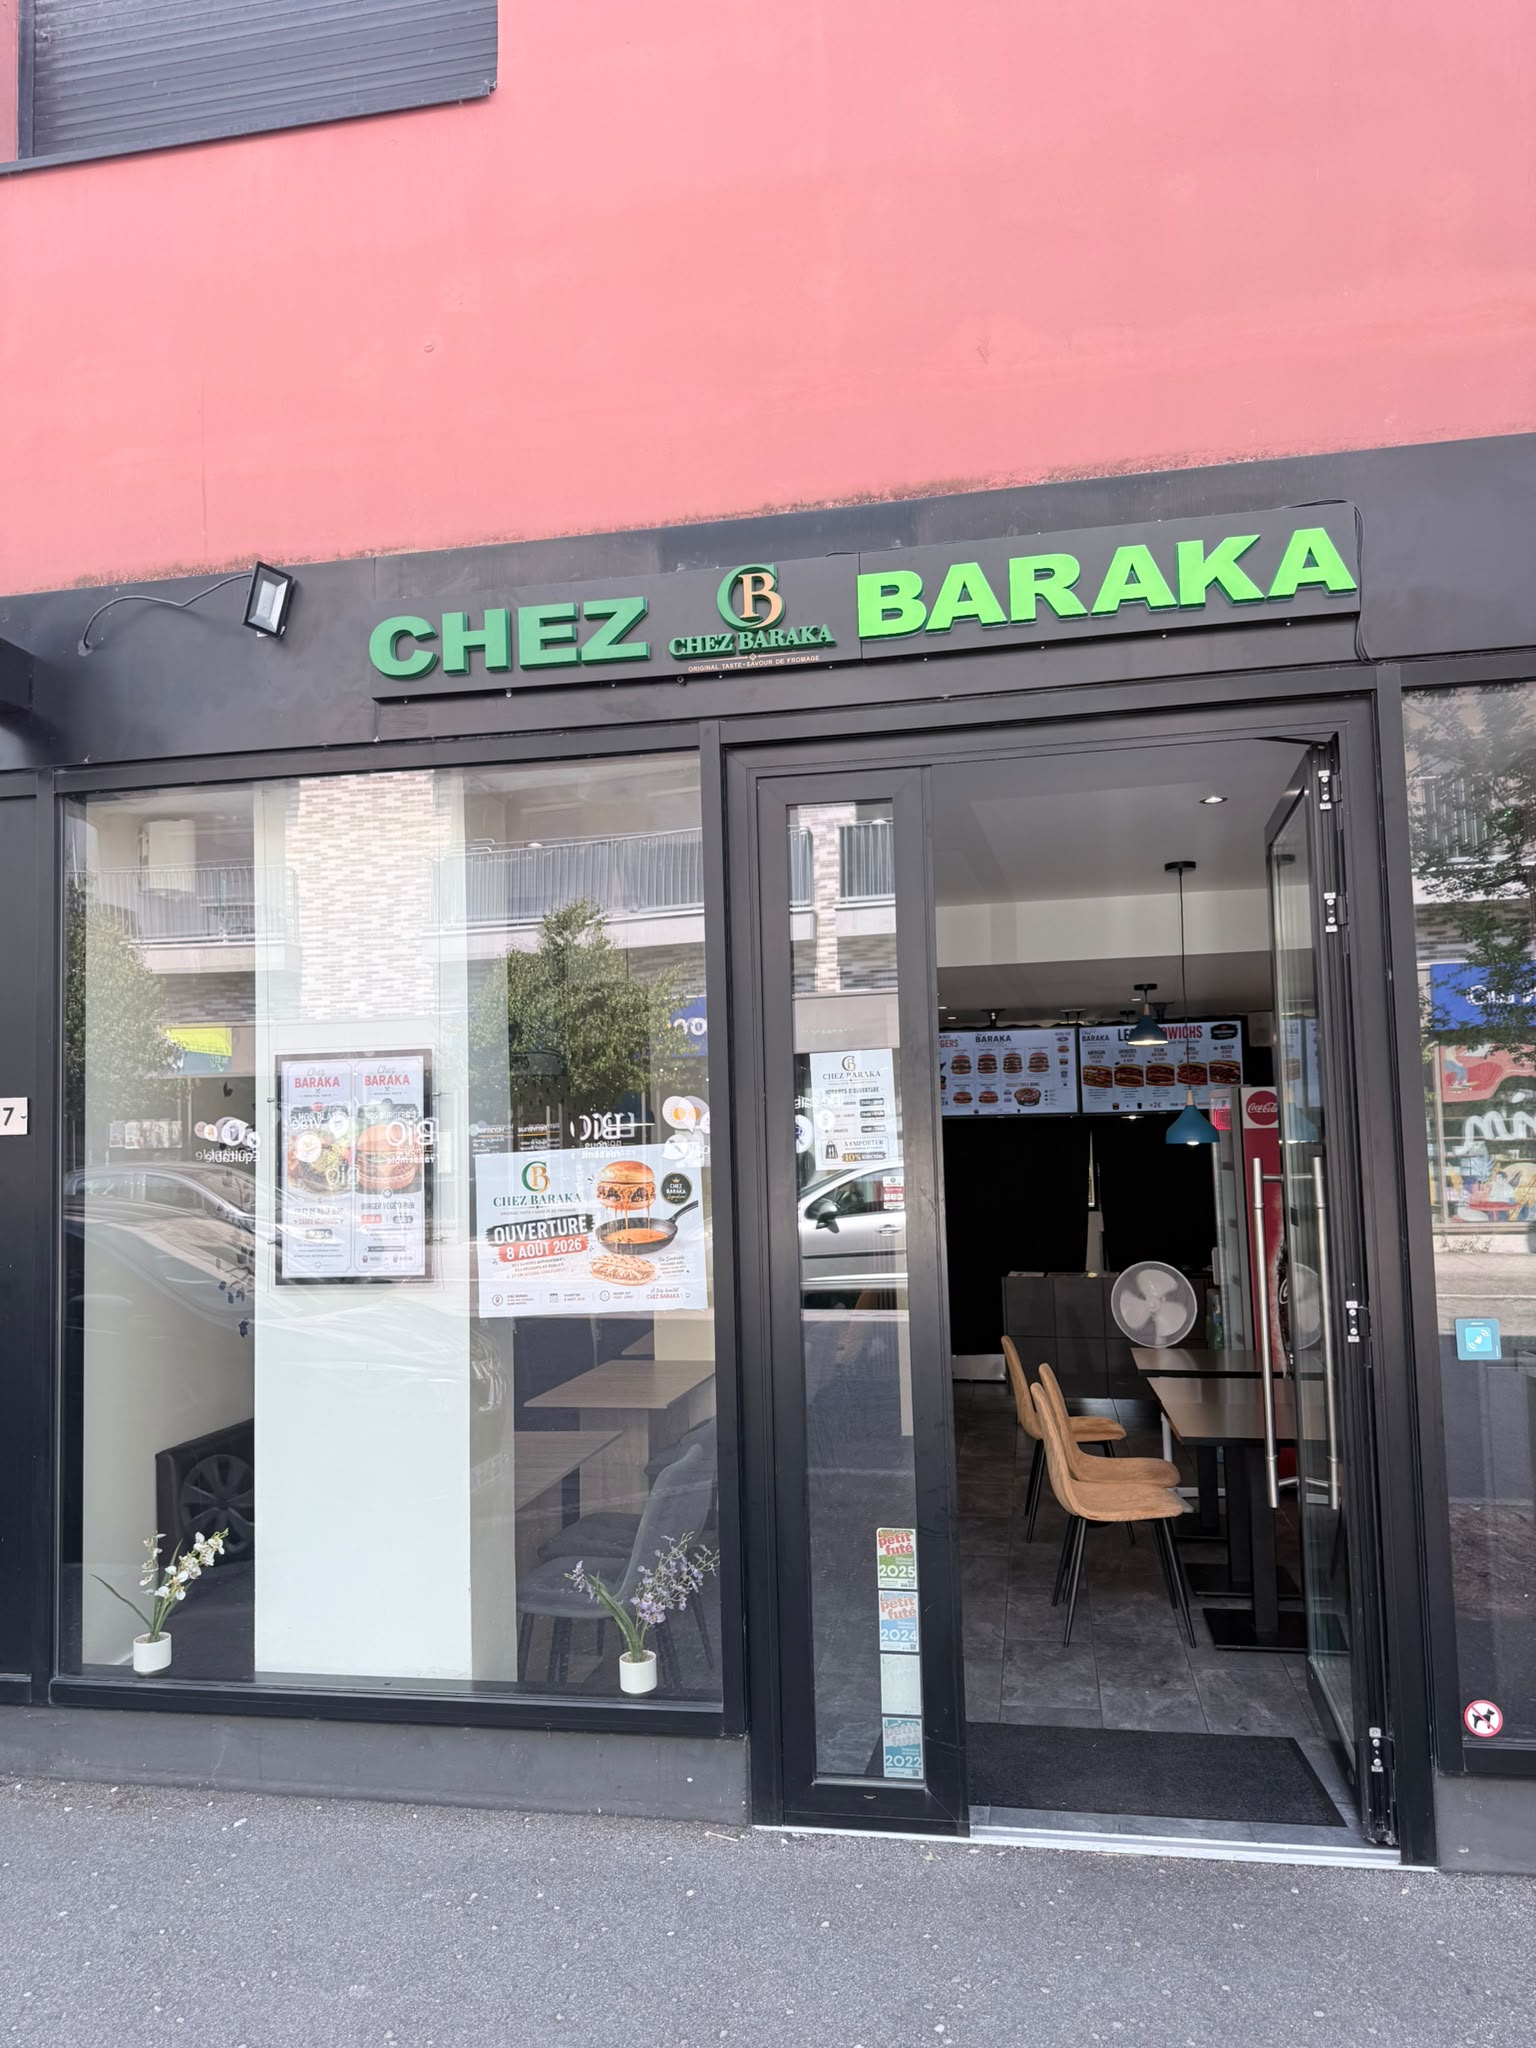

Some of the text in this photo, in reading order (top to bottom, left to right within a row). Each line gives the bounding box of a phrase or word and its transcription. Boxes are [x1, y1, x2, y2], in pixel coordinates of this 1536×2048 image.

[368, 527, 1358, 679] CHEZ BARAKA
[668, 624, 837, 660] CHEZ BARAKA
[688, 665, 720, 673] ORIGINAL
[787, 655, 820, 664] FROMAGE
[976, 1035, 1012, 1043] BARAKA
[1082, 1034, 1110, 1042] BARAKA
[364, 1074, 410, 1086] BARAKA
[846, 1070, 881, 1079] BARAKA
[294, 1076, 340, 1088] BARAKA
[493, 1193, 582, 1207] CHEZ BARAKA
[494, 1215, 588, 1245] OUVERTURE
[506, 1246, 515, 1260] 8
[553, 1238, 582, 1254] 2026
[878, 1531, 912, 1549] petit
[885, 1542, 914, 1556] futé
[879, 1564, 915, 1578] 2025
[880, 1596, 915, 1613] petit
[887, 1606, 917, 1620] futé
[881, 1629, 917, 1642] 2024
[886, 1755, 921, 1768] 2022
